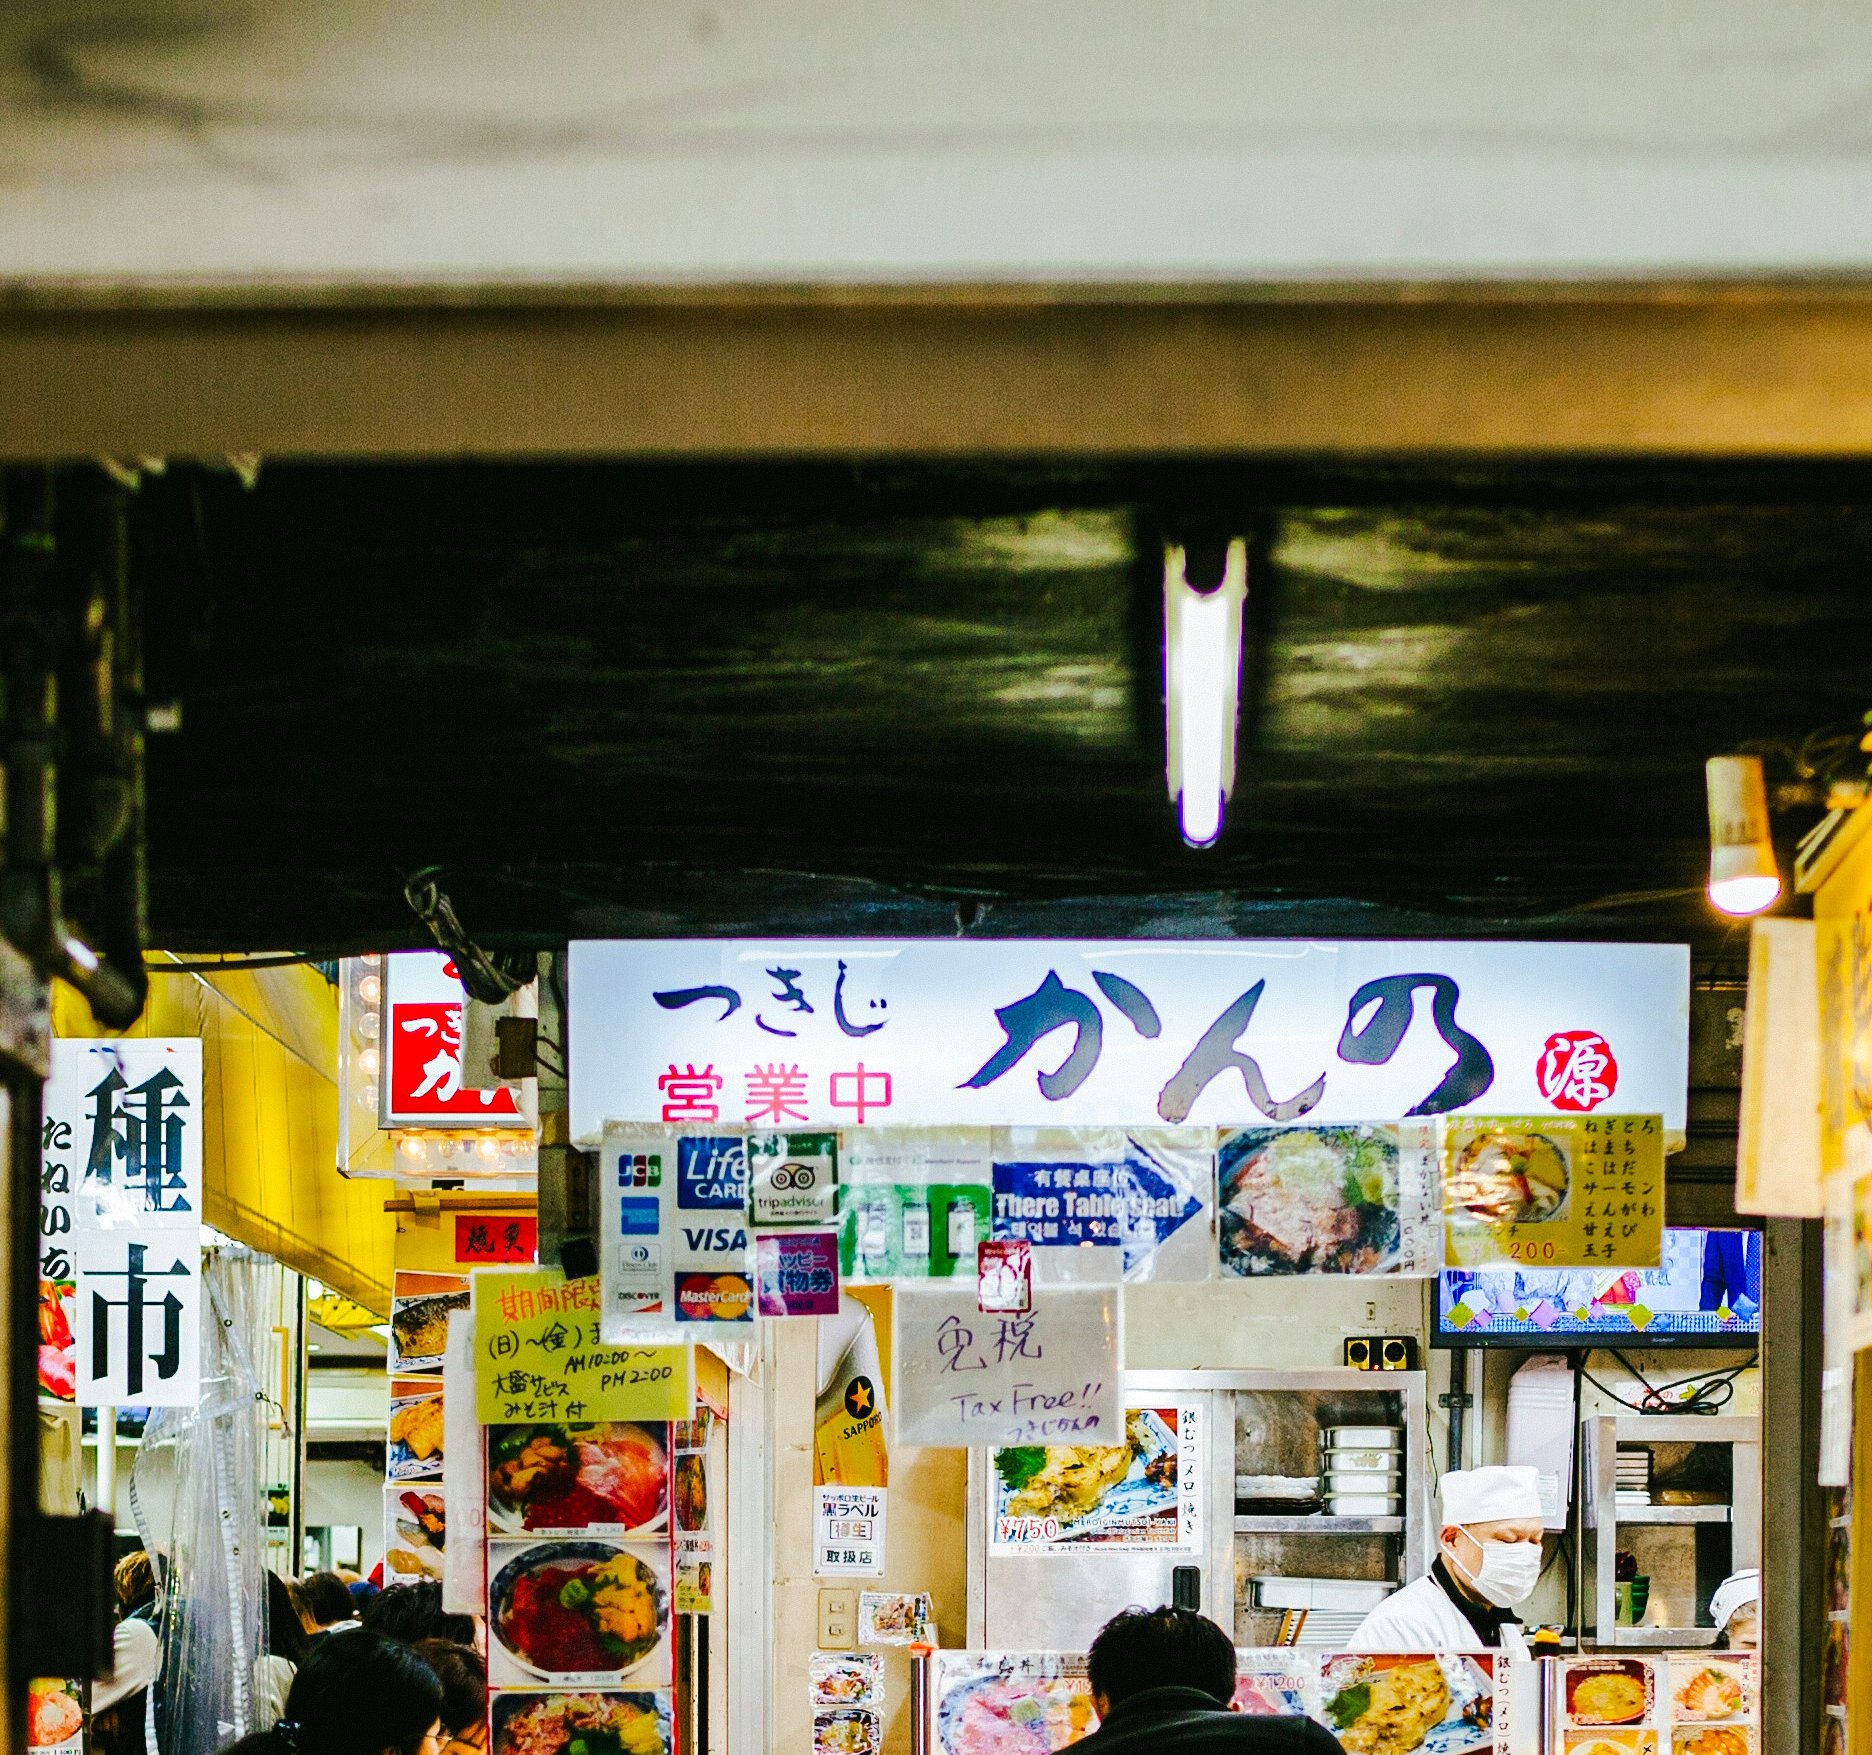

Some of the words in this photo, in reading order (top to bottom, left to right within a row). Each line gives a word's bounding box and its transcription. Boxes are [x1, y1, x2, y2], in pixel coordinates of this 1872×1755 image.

[652, 959, 891, 1037] つきじ
[954, 968, 1494, 1125] かんの
[1544, 1036, 1611, 1106] 源
[658, 1062, 892, 1124] 営業中
[1584, 1119, 1655, 1135] ねぎとろ
[1584, 1139, 1635, 1155] はまち
[619, 1165, 659, 1177] JCB
[1585, 1161, 1636, 1175] こはだ
[41, 1116, 72, 1280] たねいち
[1582, 1181, 1655, 1195] サーモン
[995, 1192, 1060, 1218] There
[1583, 1201, 1656, 1217] えんがわ
[84, 1066, 191, 1396] 種市
[681, 1227, 747, 1252] VISA
[1583, 1222, 1639, 1238] 甘えび
[950, 1393, 1002, 1423] Tax
[822, 1502, 880, 1518] 黒ラベル
[999, 1517, 1058, 1541] ¥750
[826, 1549, 873, 1564] 取扱店
[1255, 1675, 1306, 1691] ¥1200
